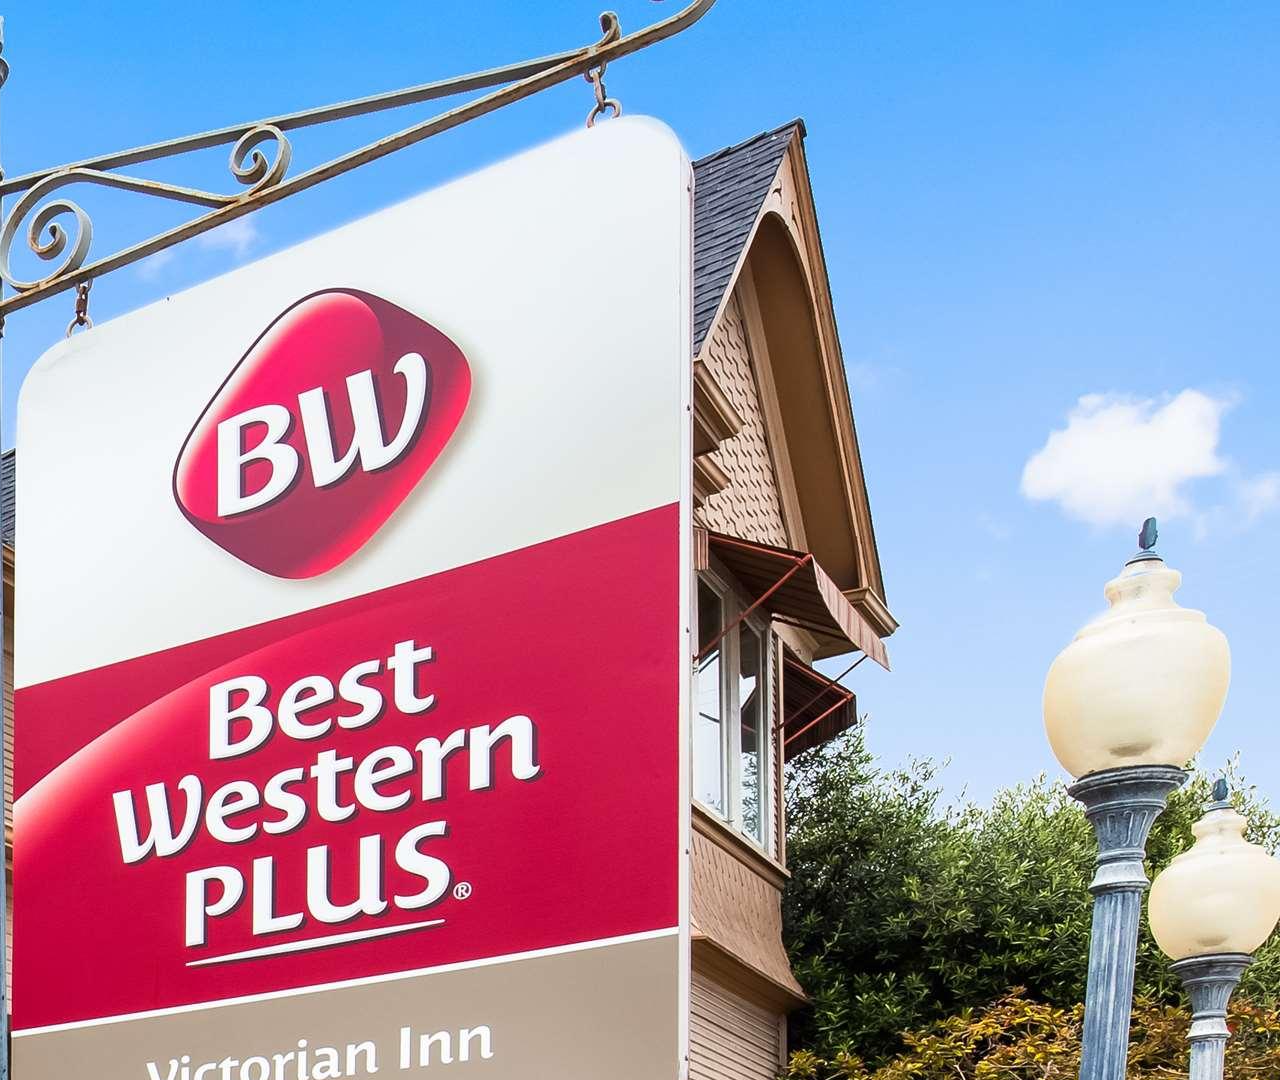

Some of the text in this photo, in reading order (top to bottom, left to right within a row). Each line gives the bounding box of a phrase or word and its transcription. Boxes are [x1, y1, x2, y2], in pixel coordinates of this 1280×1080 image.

[216, 351, 428, 518] BW
[208, 638, 436, 761] Best
[111, 714, 541, 865] Western
[398, 1024, 495, 1071] Inn
